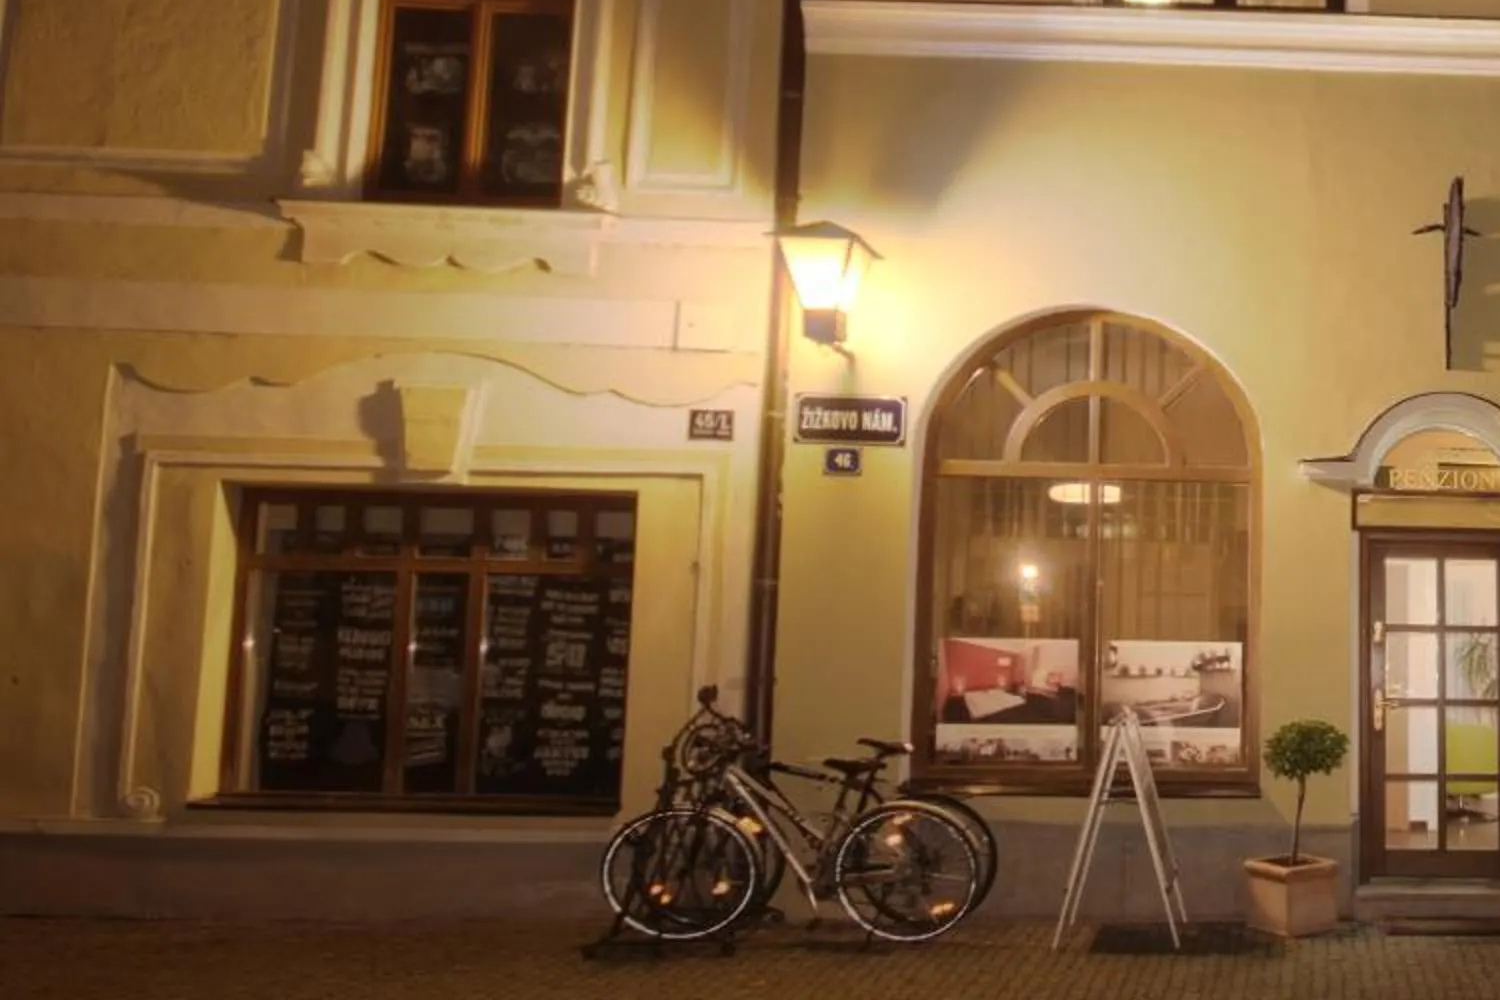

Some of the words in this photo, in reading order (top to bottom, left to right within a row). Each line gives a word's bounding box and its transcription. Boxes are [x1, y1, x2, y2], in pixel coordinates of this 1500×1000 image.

[801, 406, 859, 432] ŽIŽKOVO
[862, 408, 898, 433] NÁM.
[1389, 469, 1496, 490] PENZION
